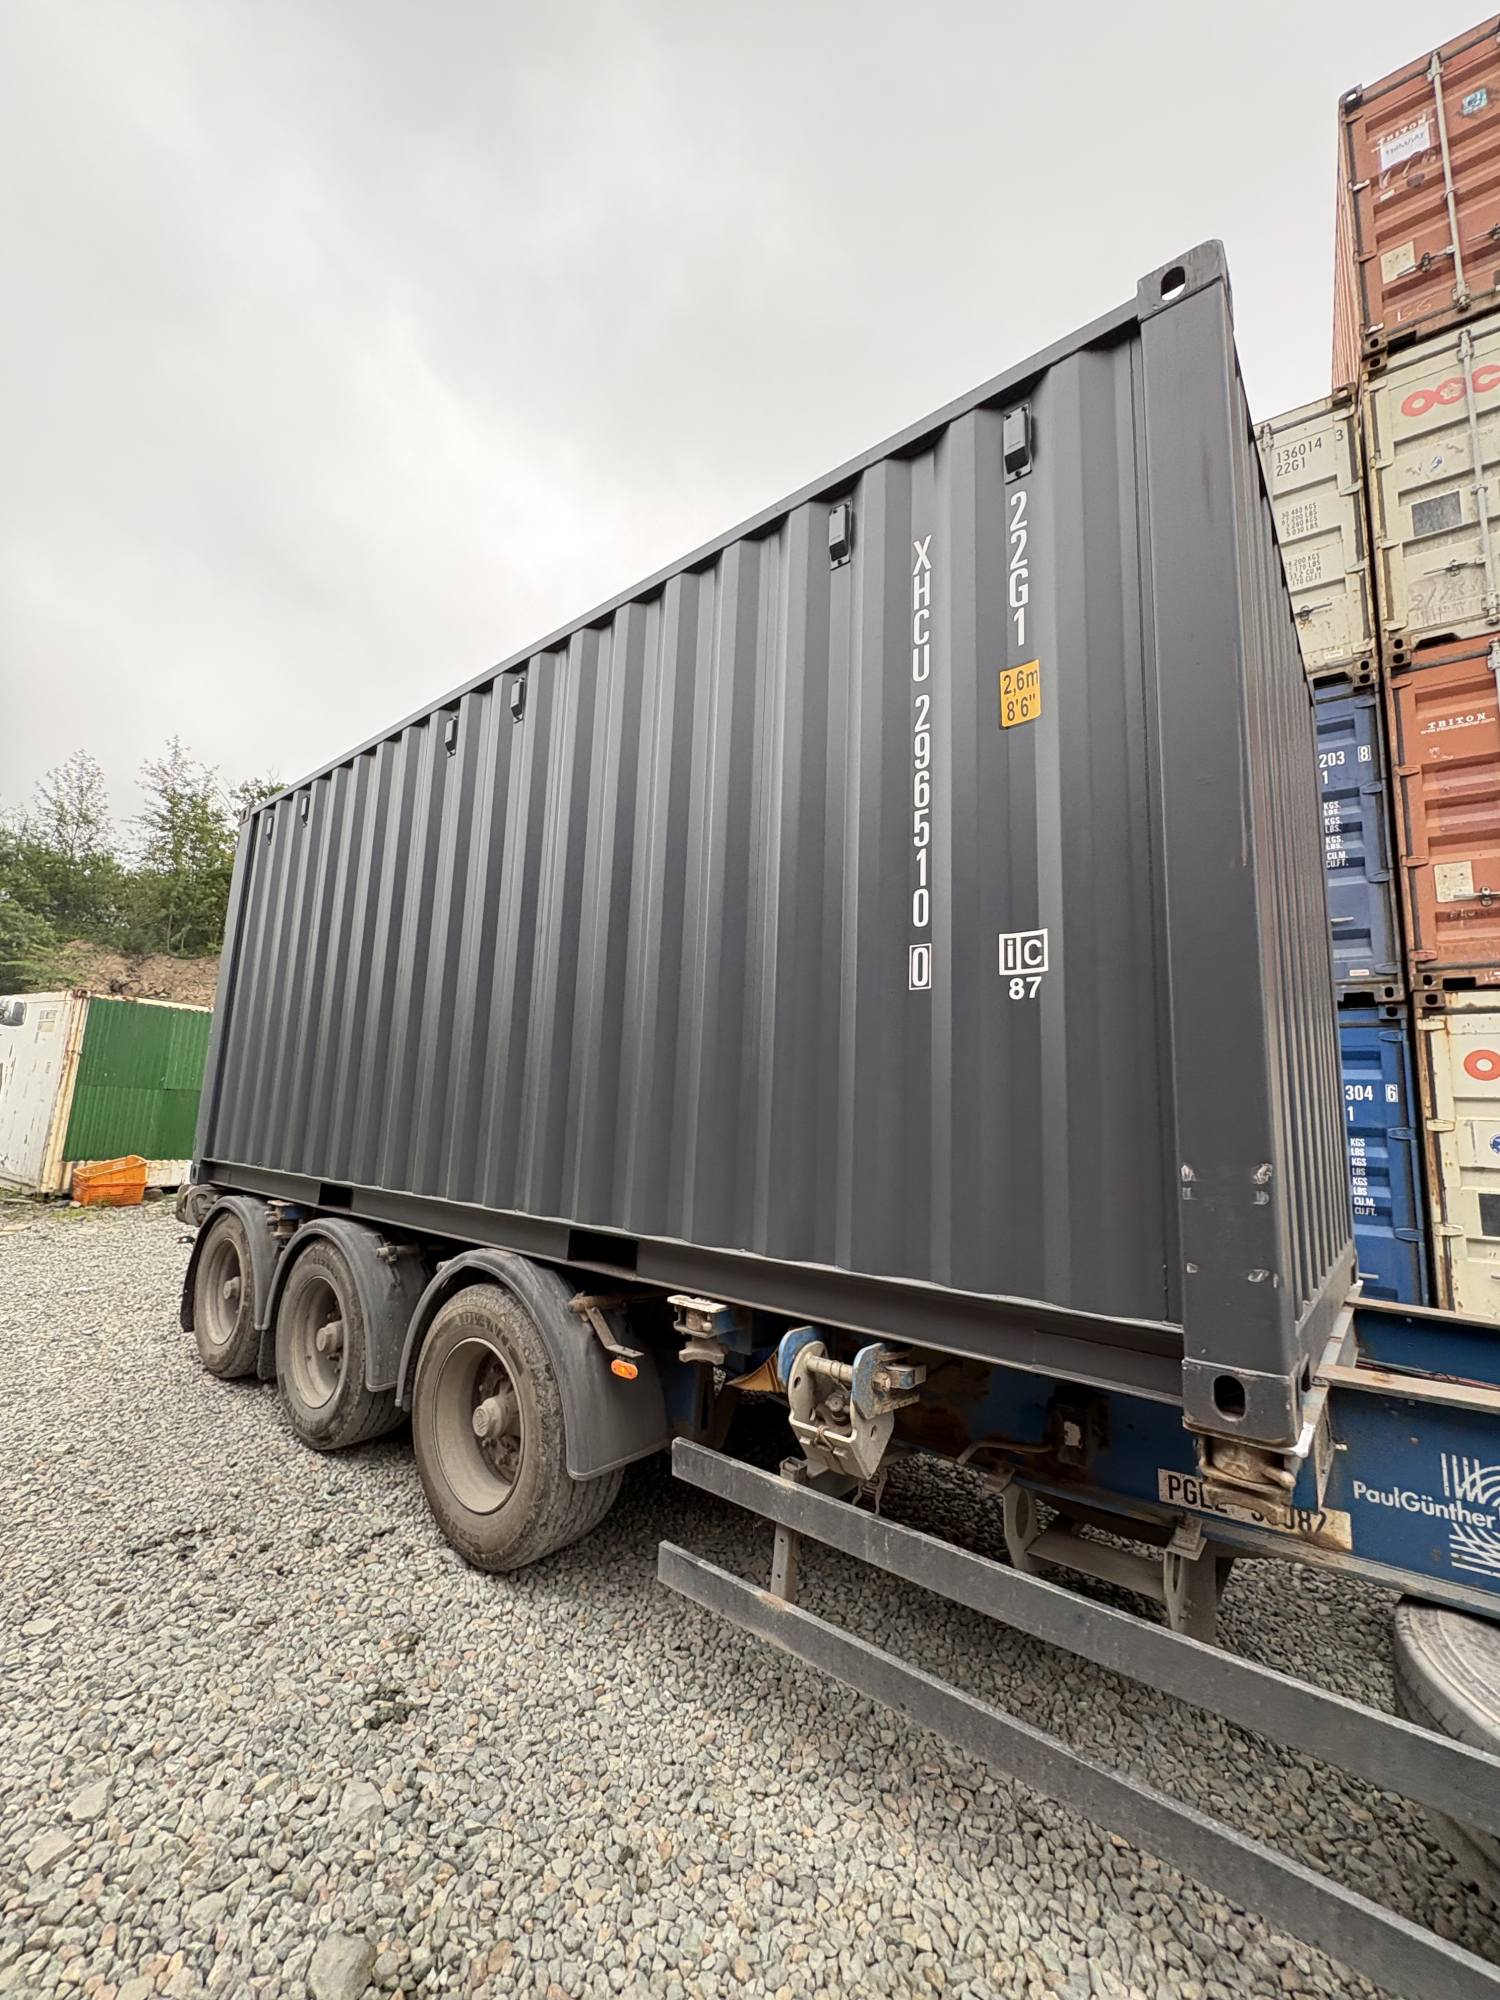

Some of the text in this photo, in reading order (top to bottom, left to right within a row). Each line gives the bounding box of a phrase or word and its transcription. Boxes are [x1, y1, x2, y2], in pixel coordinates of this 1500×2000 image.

[1277, 429, 1344, 463] 136014 3
[1276, 457, 1305, 475] 22G1
[1009, 491, 1028, 646] 22G1
[1003, 669, 1038, 697] 2,6m
[1427, 712, 1486, 730] TRITON
[911, 534, 931, 989] XHCU 296510 0
[1318, 746, 1369, 768] 203 8
[1009, 976, 1042, 1000] 87
[1345, 1084, 1397, 1101] 304 6
[1350, 1138, 1365, 1146] KGS
[1351, 1147, 1365, 1156] LBS
[1352, 1157, 1367, 1166] KGS
[1352, 1167, 1366, 1176] LBS
[1353, 1177, 1367, 1186] KGS
[1353, 1187, 1367, 1196] LBS
[1168, 1475, 1227, 1514] PGL
[1353, 1480, 1496, 1529] PaulGünther
